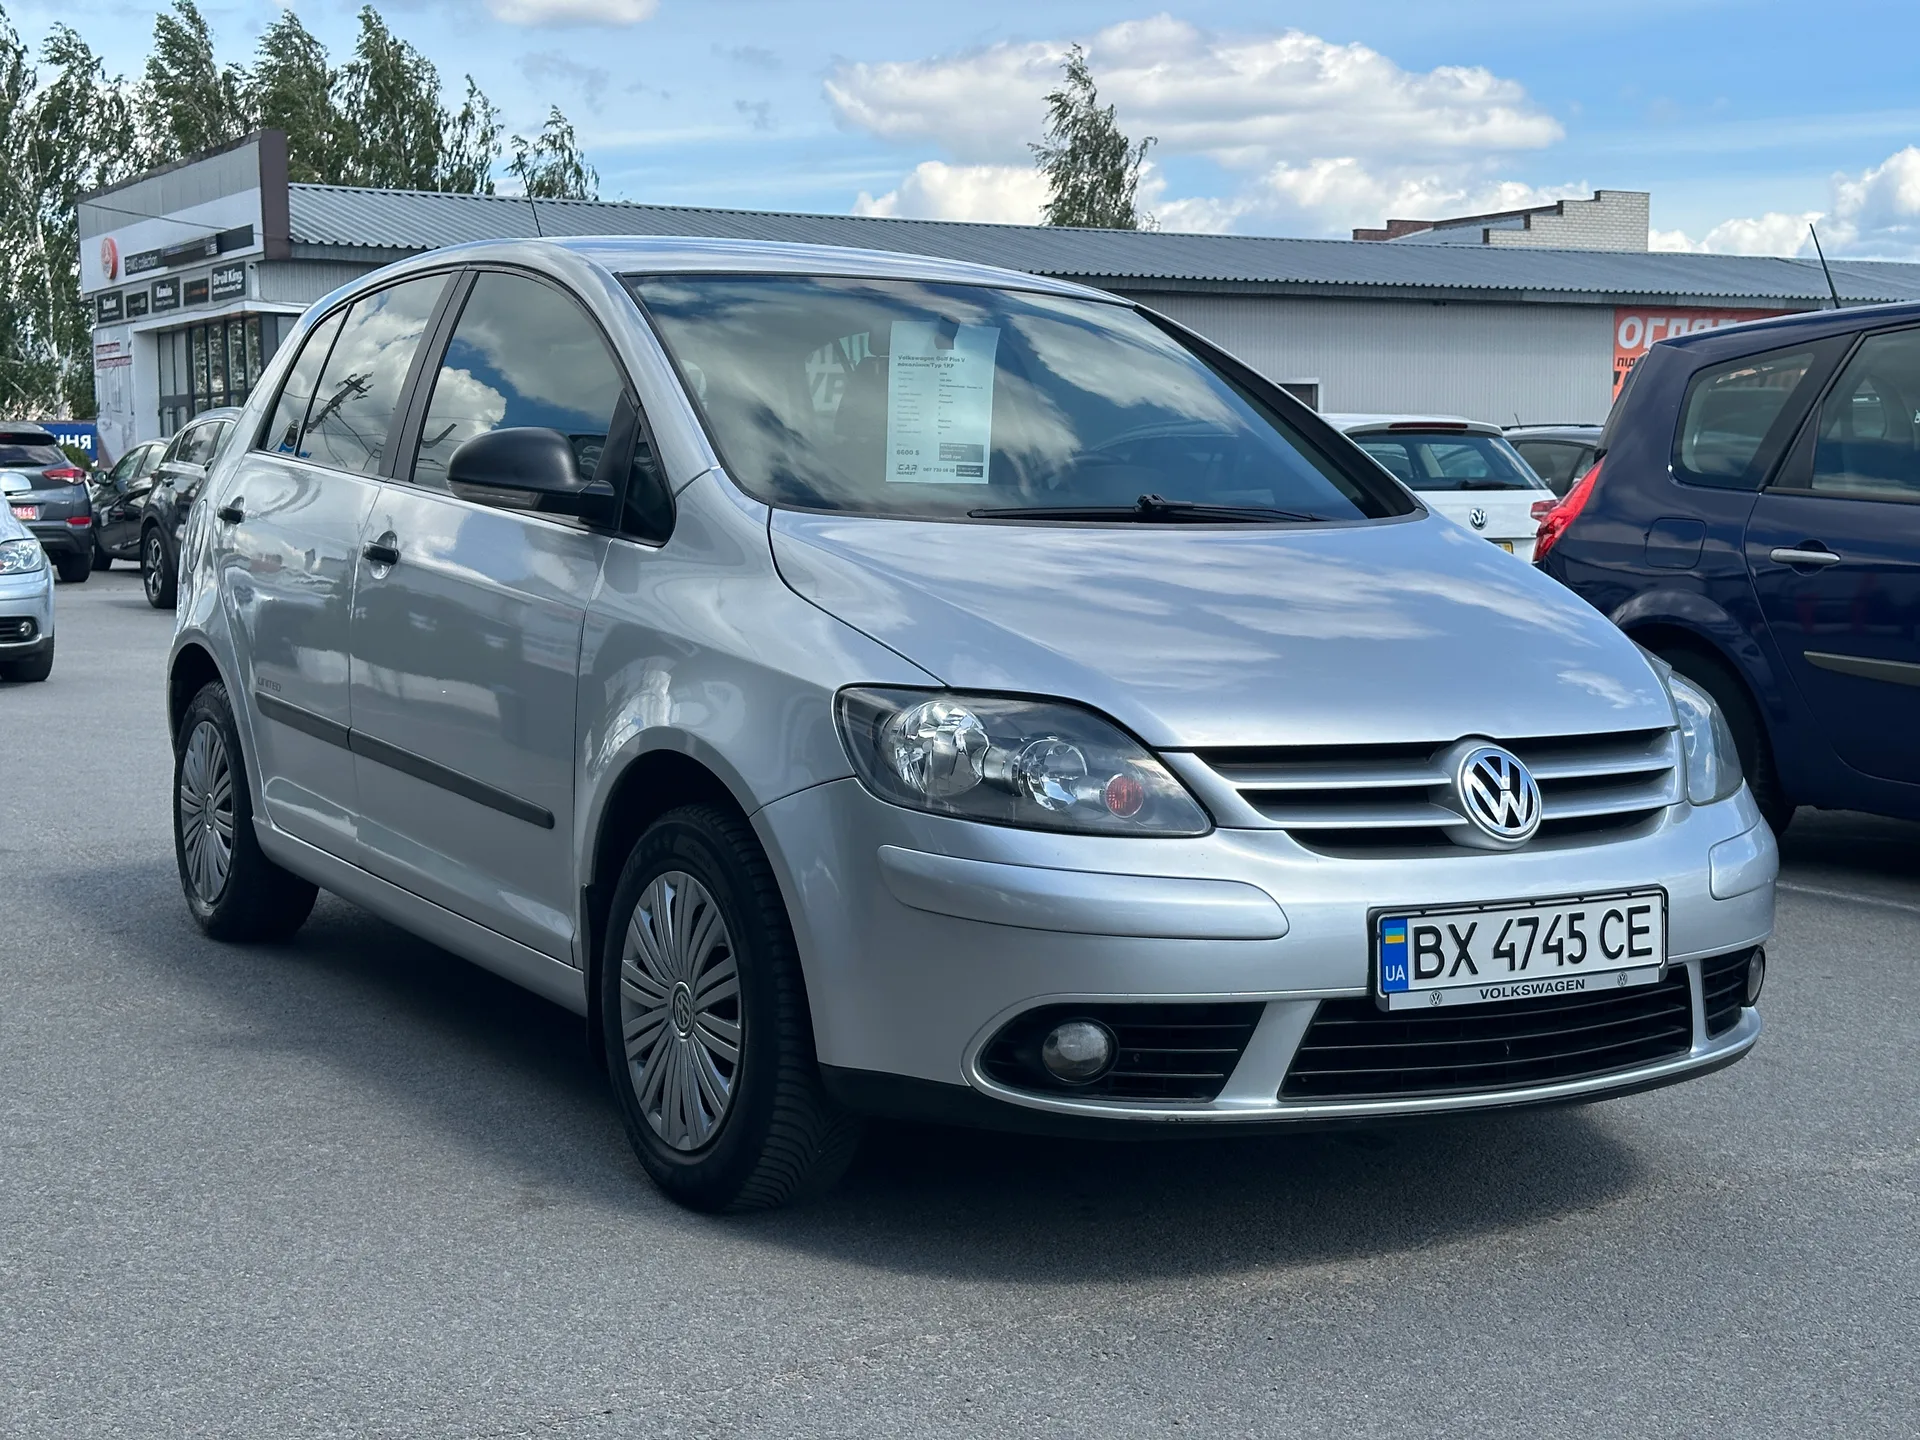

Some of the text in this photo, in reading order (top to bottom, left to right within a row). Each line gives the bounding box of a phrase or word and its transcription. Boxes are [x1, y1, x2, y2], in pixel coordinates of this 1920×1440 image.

[257, 676, 282, 692] UNITED
[1459, 746, 1541, 841] VW
[1413, 905, 1653, 980] BX 4745 CE
[1385, 964, 1406, 982] UA
[1479, 979, 1586, 1001] VOLKSWAGEN
